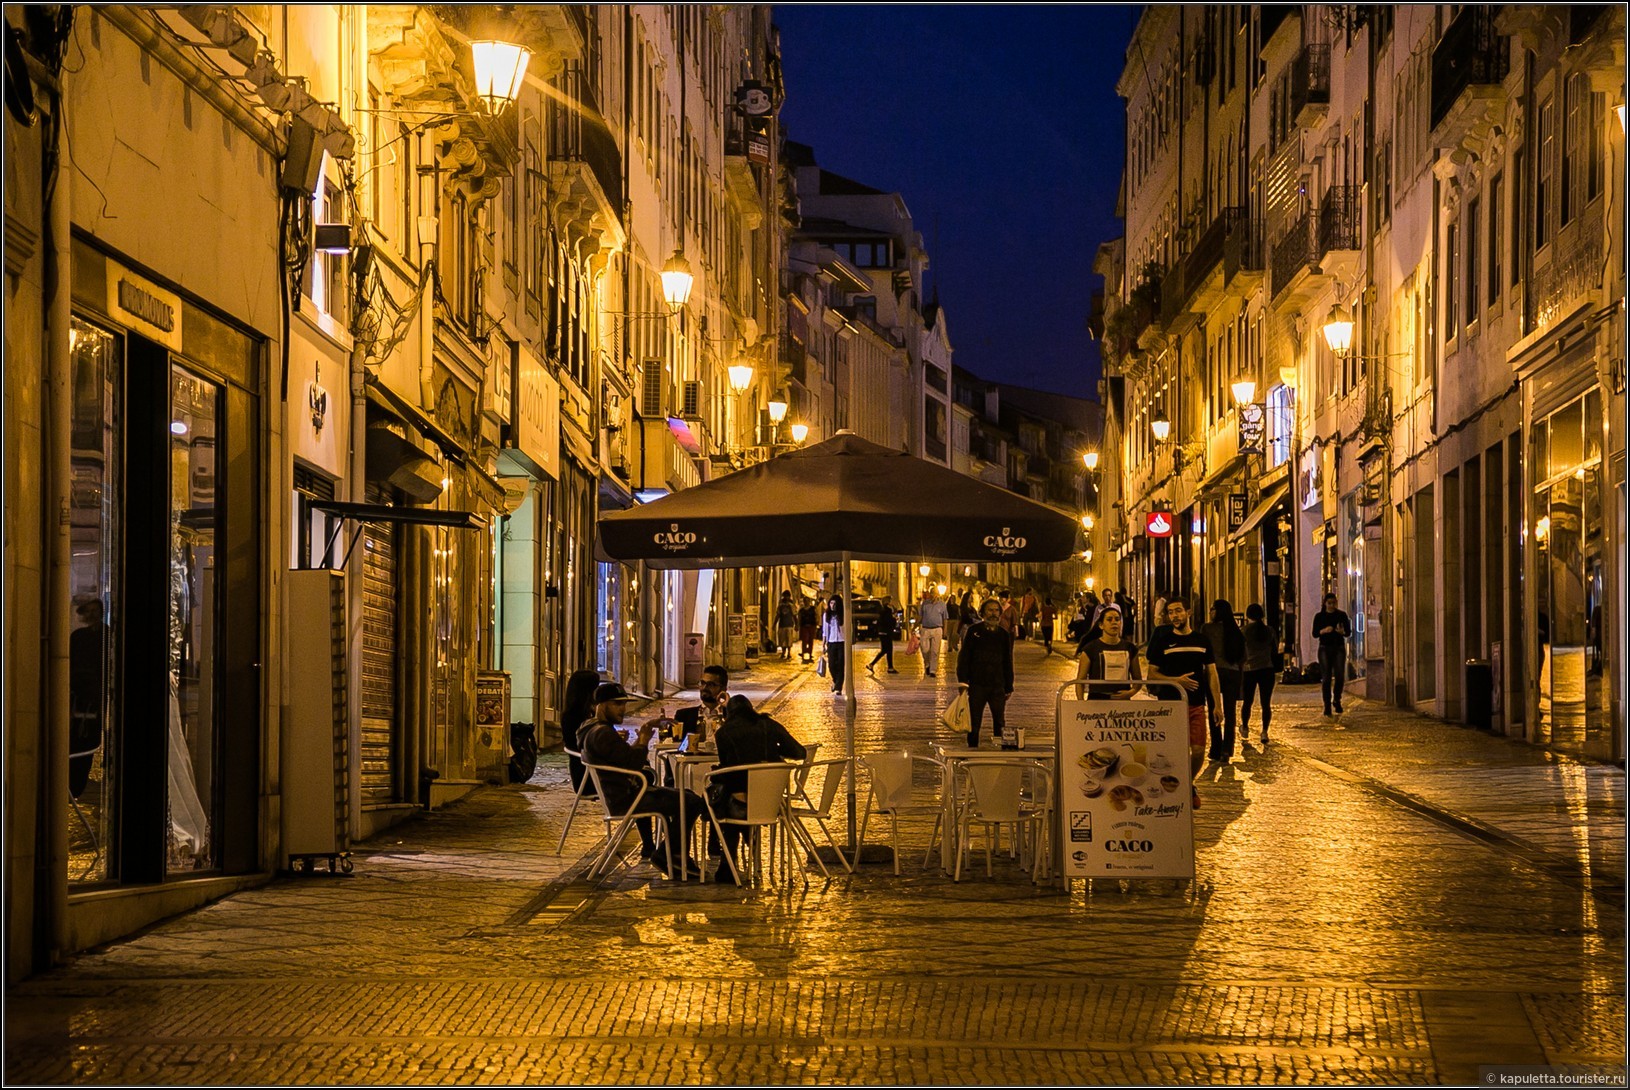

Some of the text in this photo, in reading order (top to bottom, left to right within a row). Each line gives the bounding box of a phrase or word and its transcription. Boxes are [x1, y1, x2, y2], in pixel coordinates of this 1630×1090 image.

[653, 531, 698, 545] CACO
[983, 535, 1027, 549] CACO
[1094, 719, 1156, 731] ALMOÇOS
[1084, 731, 1166, 742] & JANTARES
[1105, 840, 1154, 852] CACO
